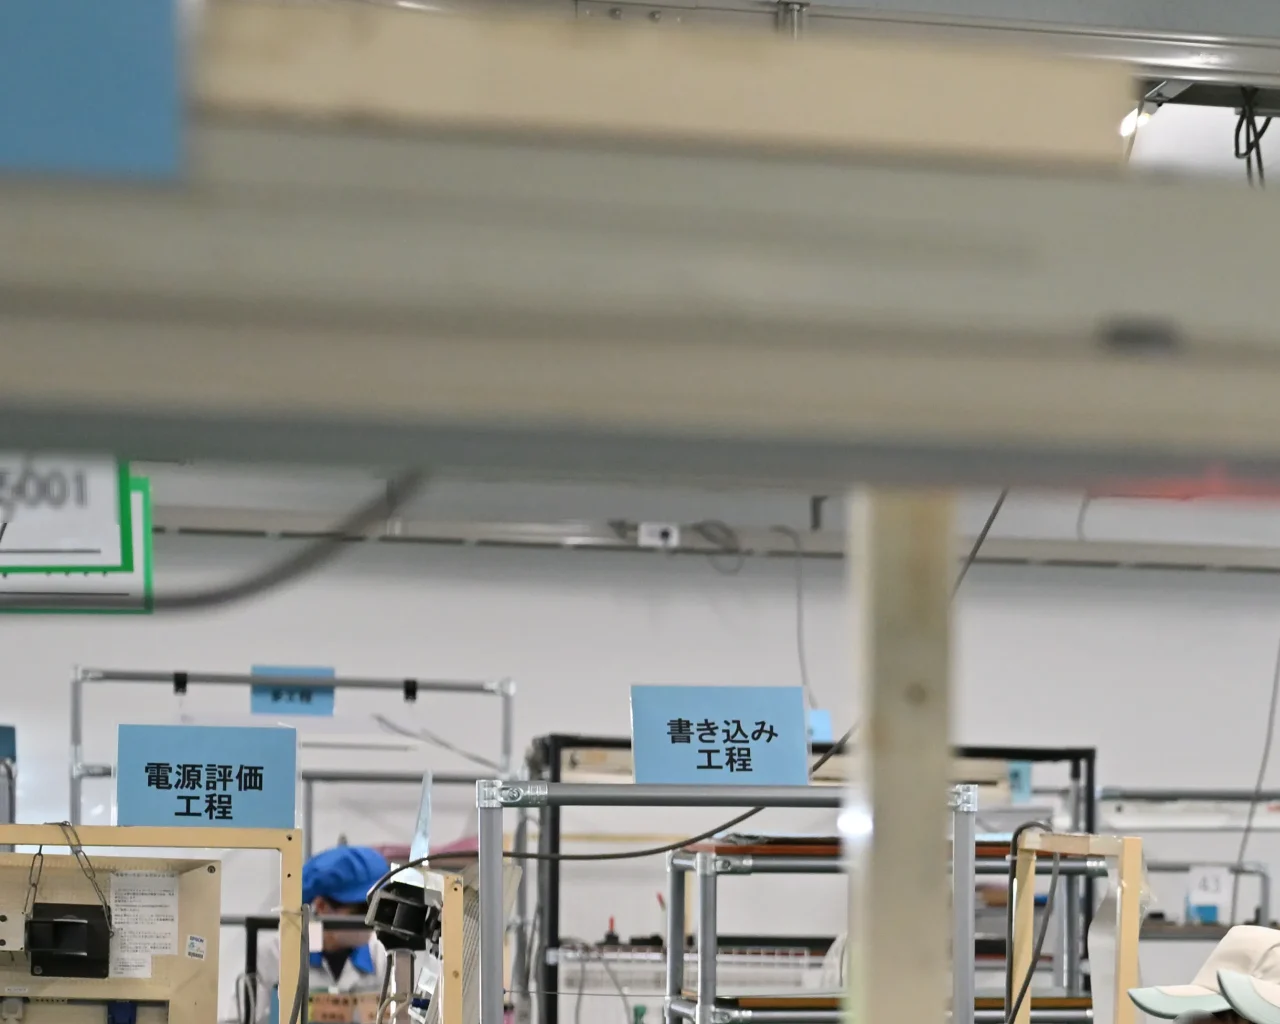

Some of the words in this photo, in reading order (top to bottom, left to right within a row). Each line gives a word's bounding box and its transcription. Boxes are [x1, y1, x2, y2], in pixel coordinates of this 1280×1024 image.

[666, 718, 779, 744] 書き込み
[696, 746, 753, 772] 工程
[144, 762, 264, 791] 電源評価
[174, 793, 233, 820] 工程
